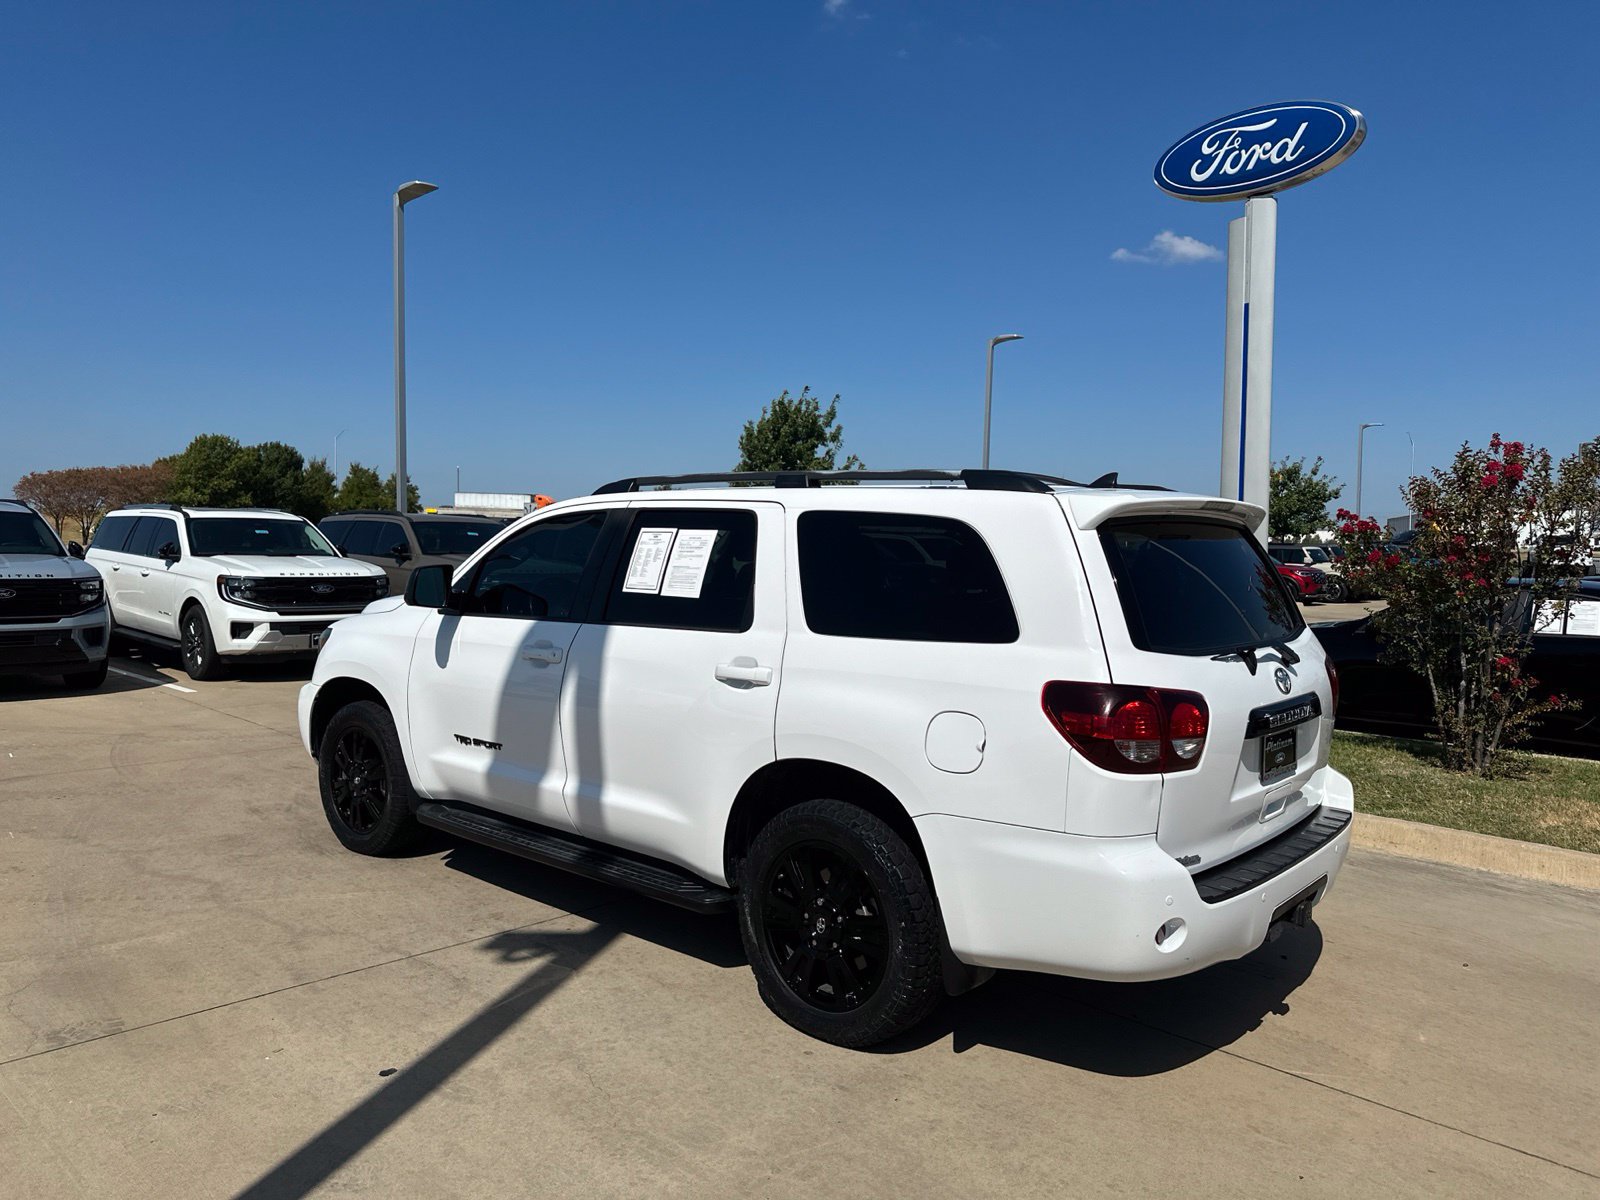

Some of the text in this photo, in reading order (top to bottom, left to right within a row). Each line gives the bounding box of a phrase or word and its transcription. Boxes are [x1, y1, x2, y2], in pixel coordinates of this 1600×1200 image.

[1190, 118, 1308, 182] Ford
[453, 733, 503, 751] TRD SPORT
